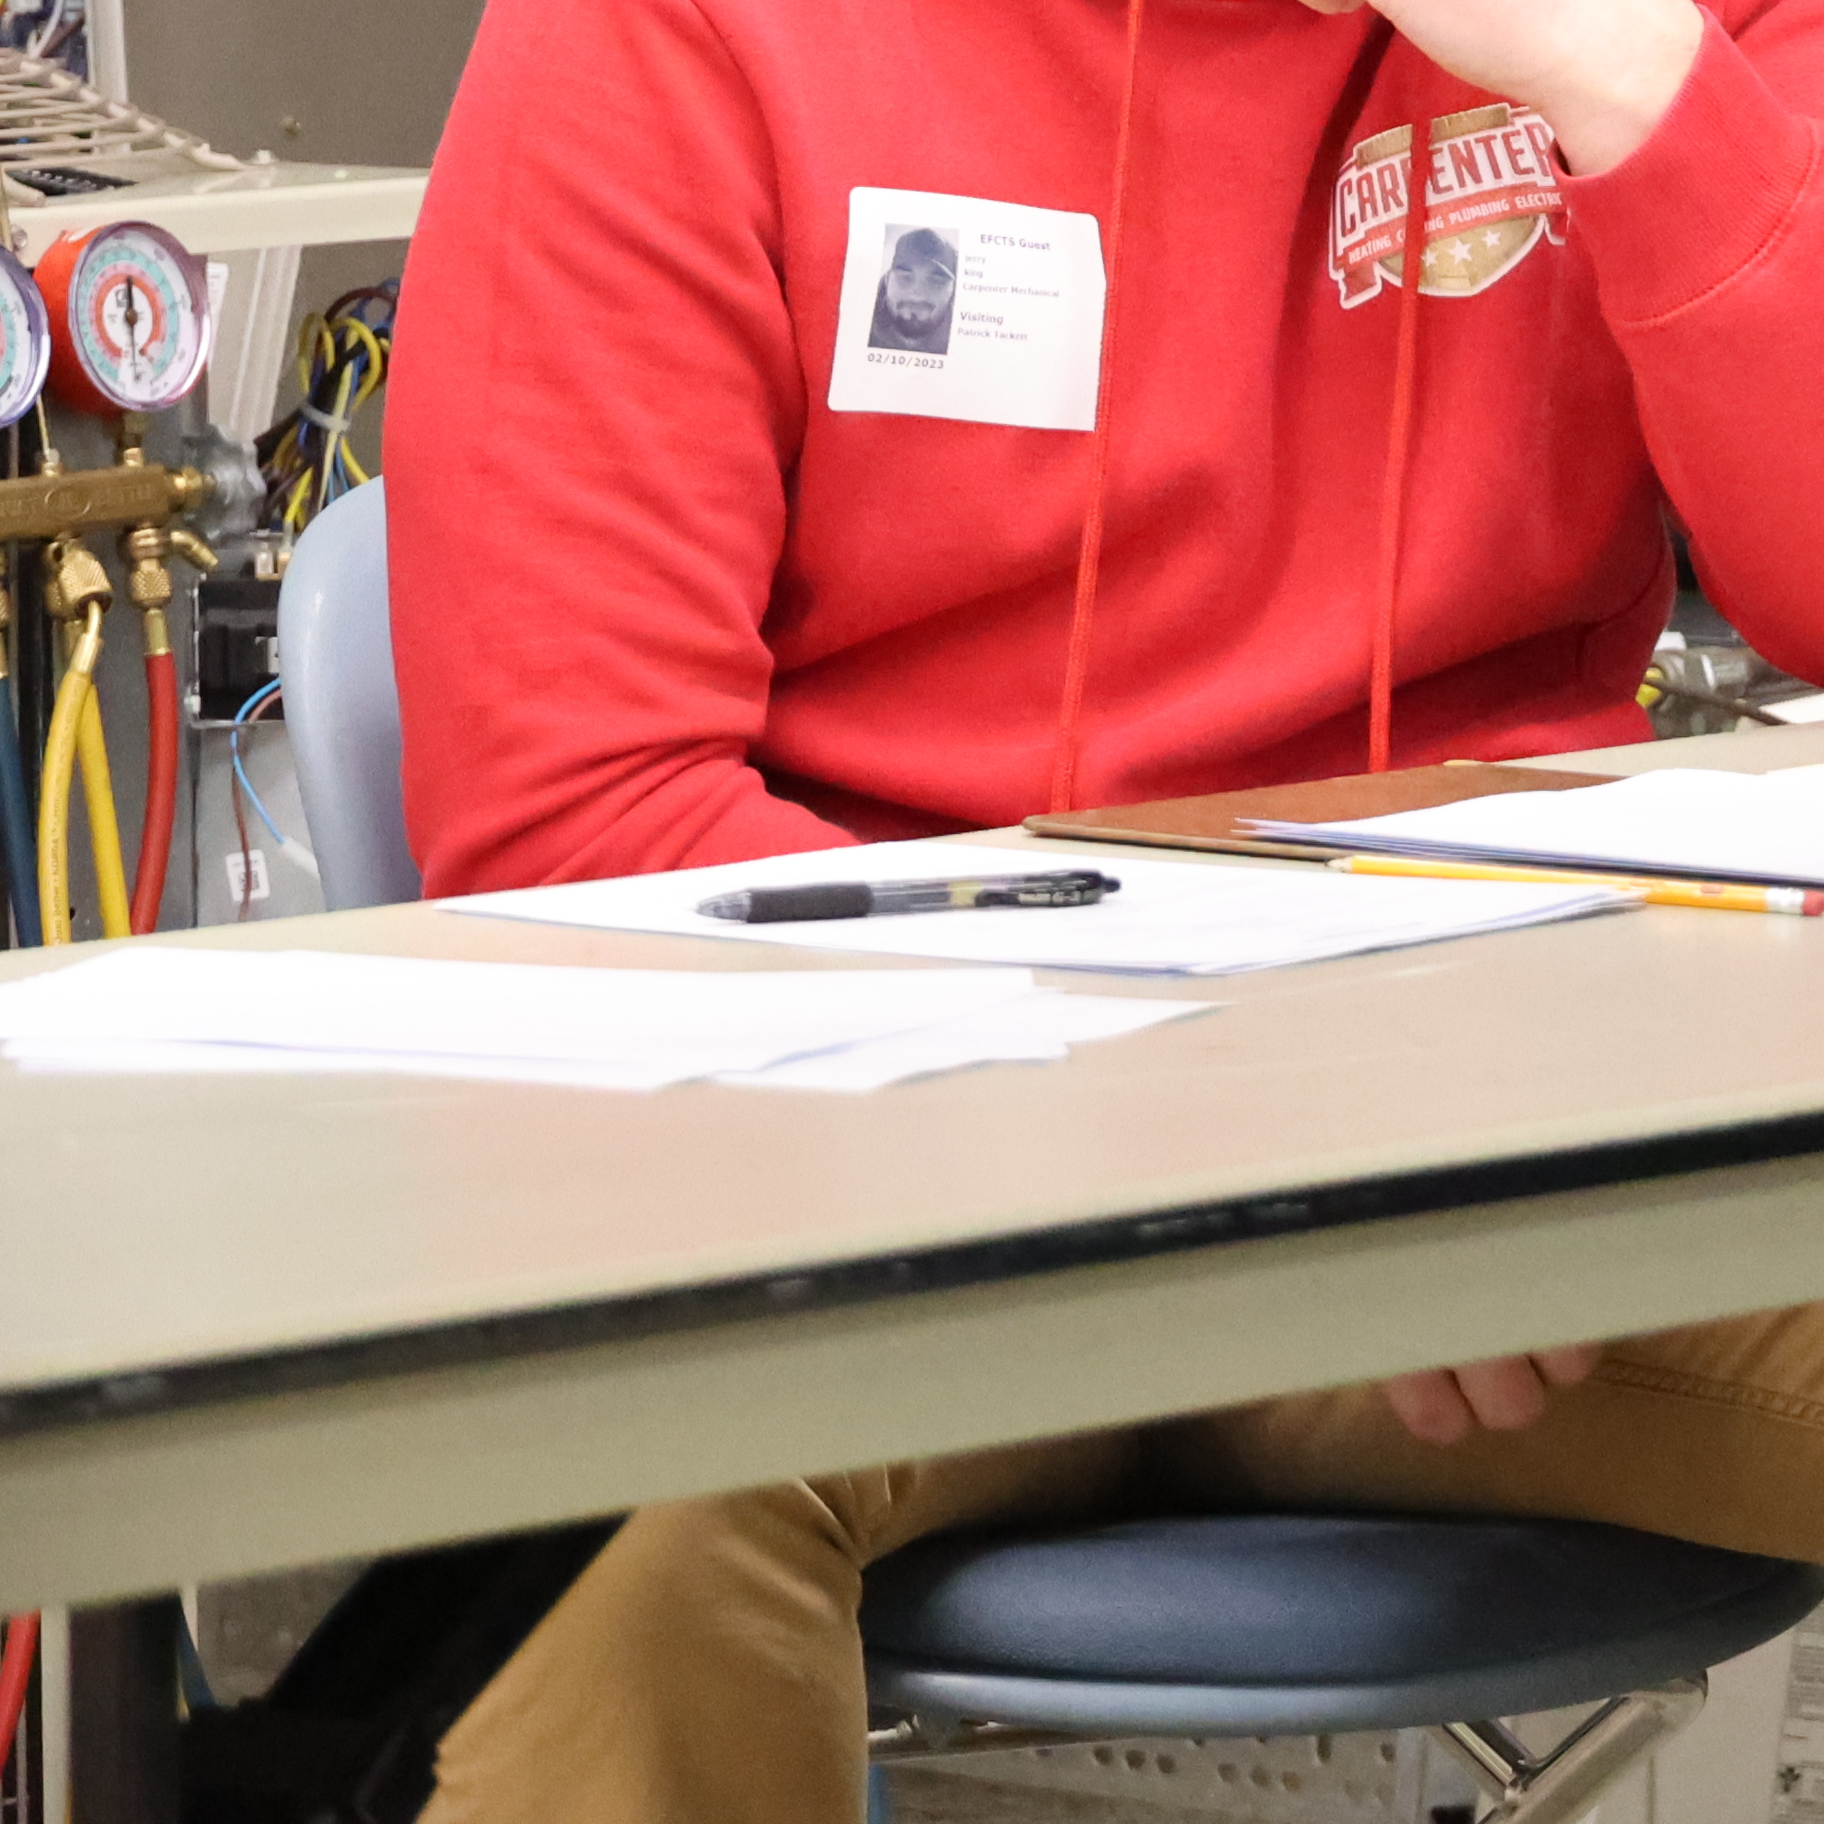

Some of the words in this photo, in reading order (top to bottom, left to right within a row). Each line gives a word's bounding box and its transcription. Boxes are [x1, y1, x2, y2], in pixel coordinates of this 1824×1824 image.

[1349, 234, 1393, 262] HEATING
[1449, 198, 1511, 225] PLUMBING
[980, 234, 1016, 247] EFCTS
[1019, 238, 1051, 251] Guest
[960, 311, 1004, 326] Visiting
[867, 353, 944, 369] 02/10/2023
